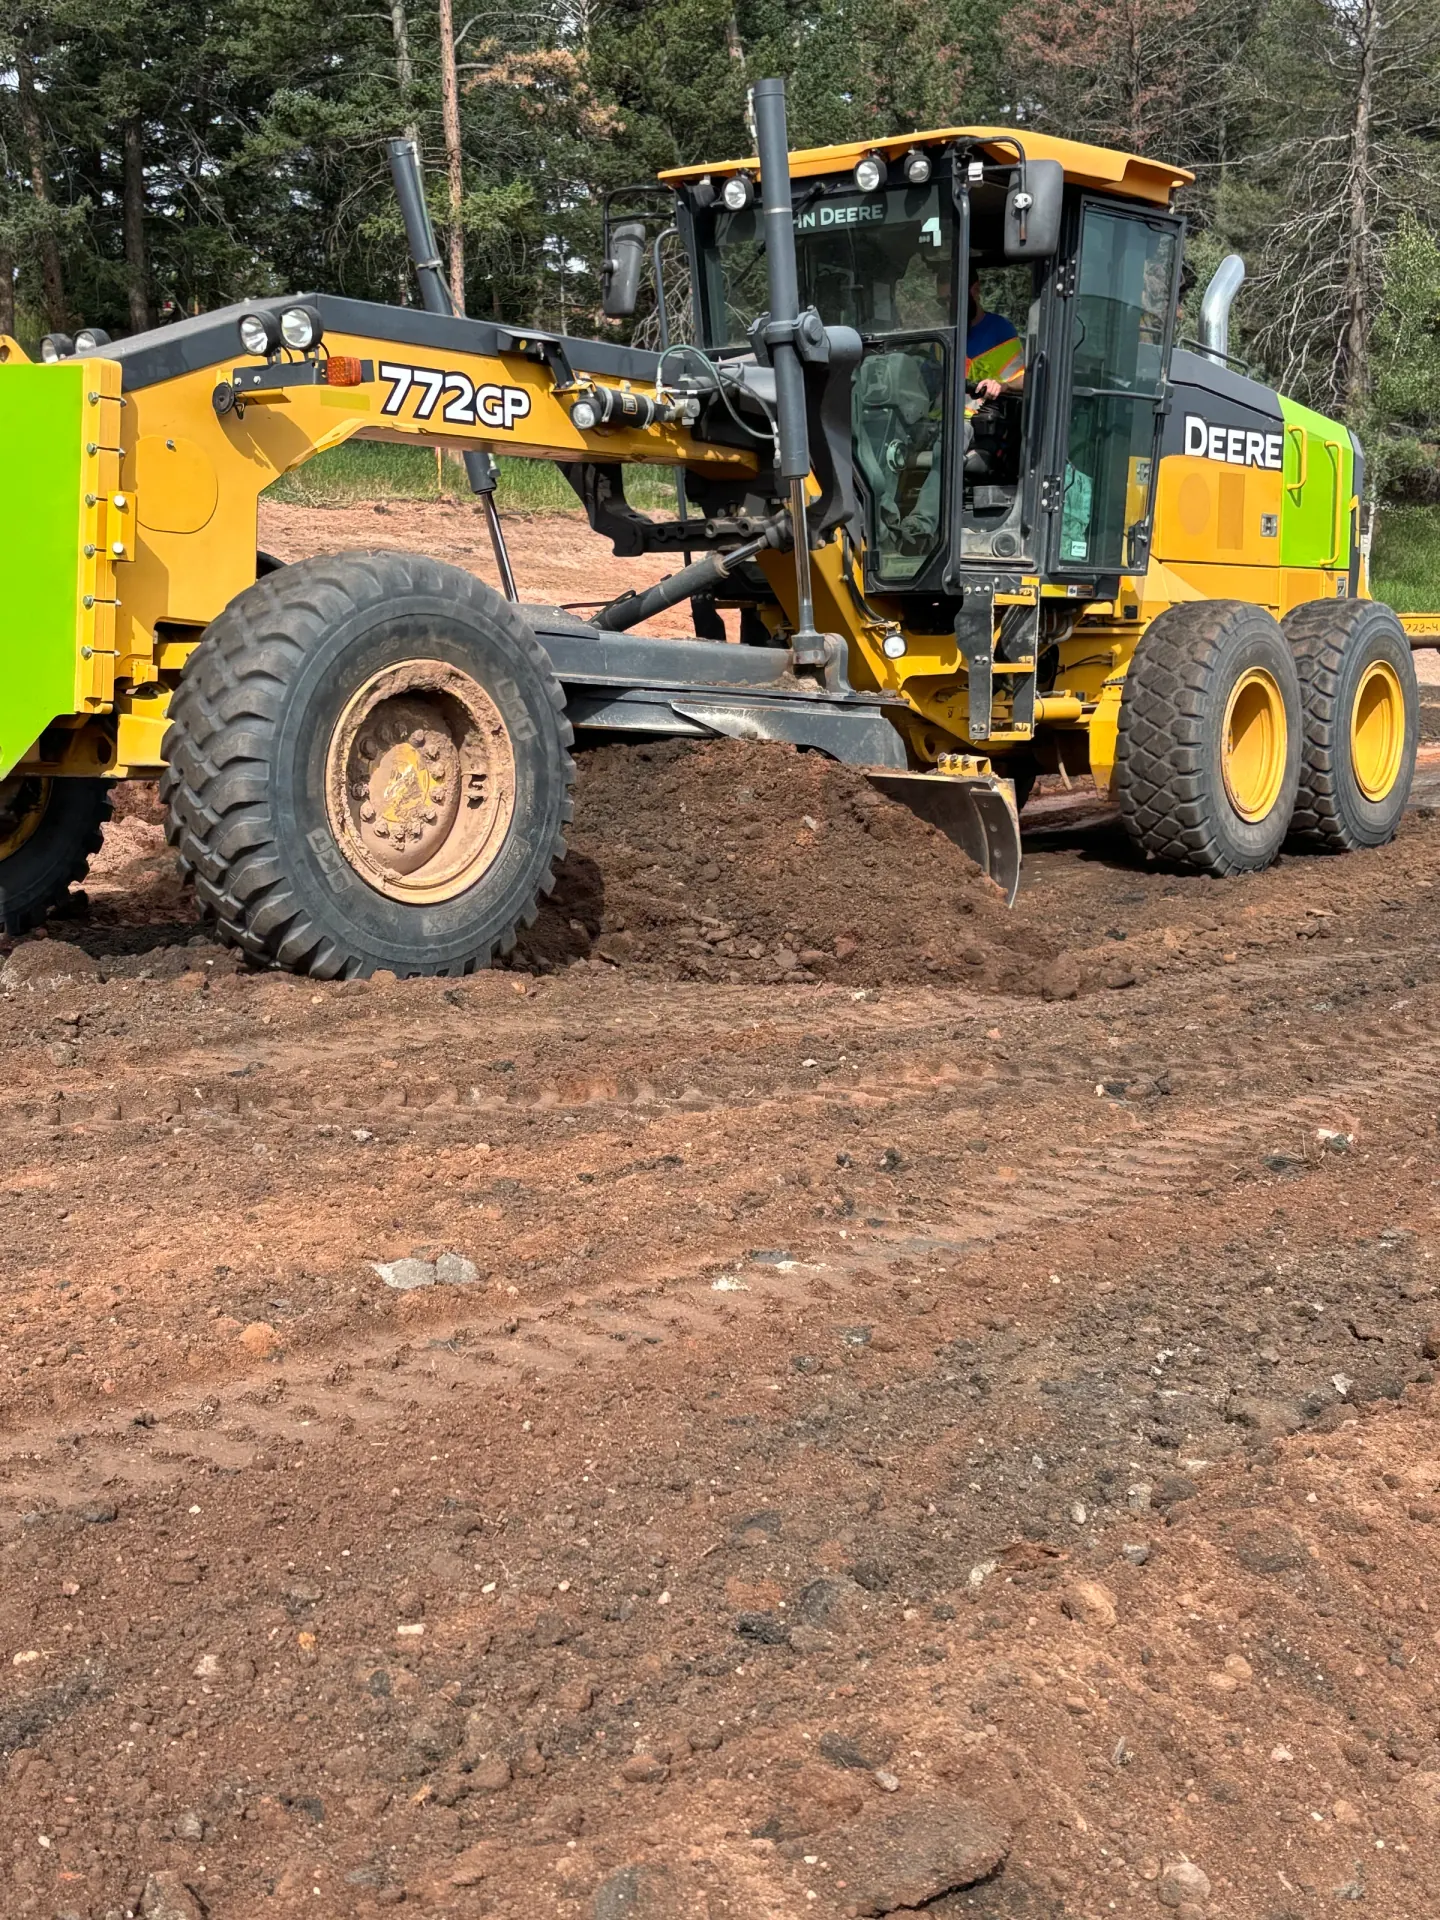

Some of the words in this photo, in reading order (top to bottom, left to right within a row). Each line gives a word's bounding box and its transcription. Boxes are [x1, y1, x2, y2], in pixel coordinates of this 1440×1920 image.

[820, 204, 884, 226] DEERE
[380, 363, 531, 429] 772GP
[1184, 416, 1283, 469] DEERE
